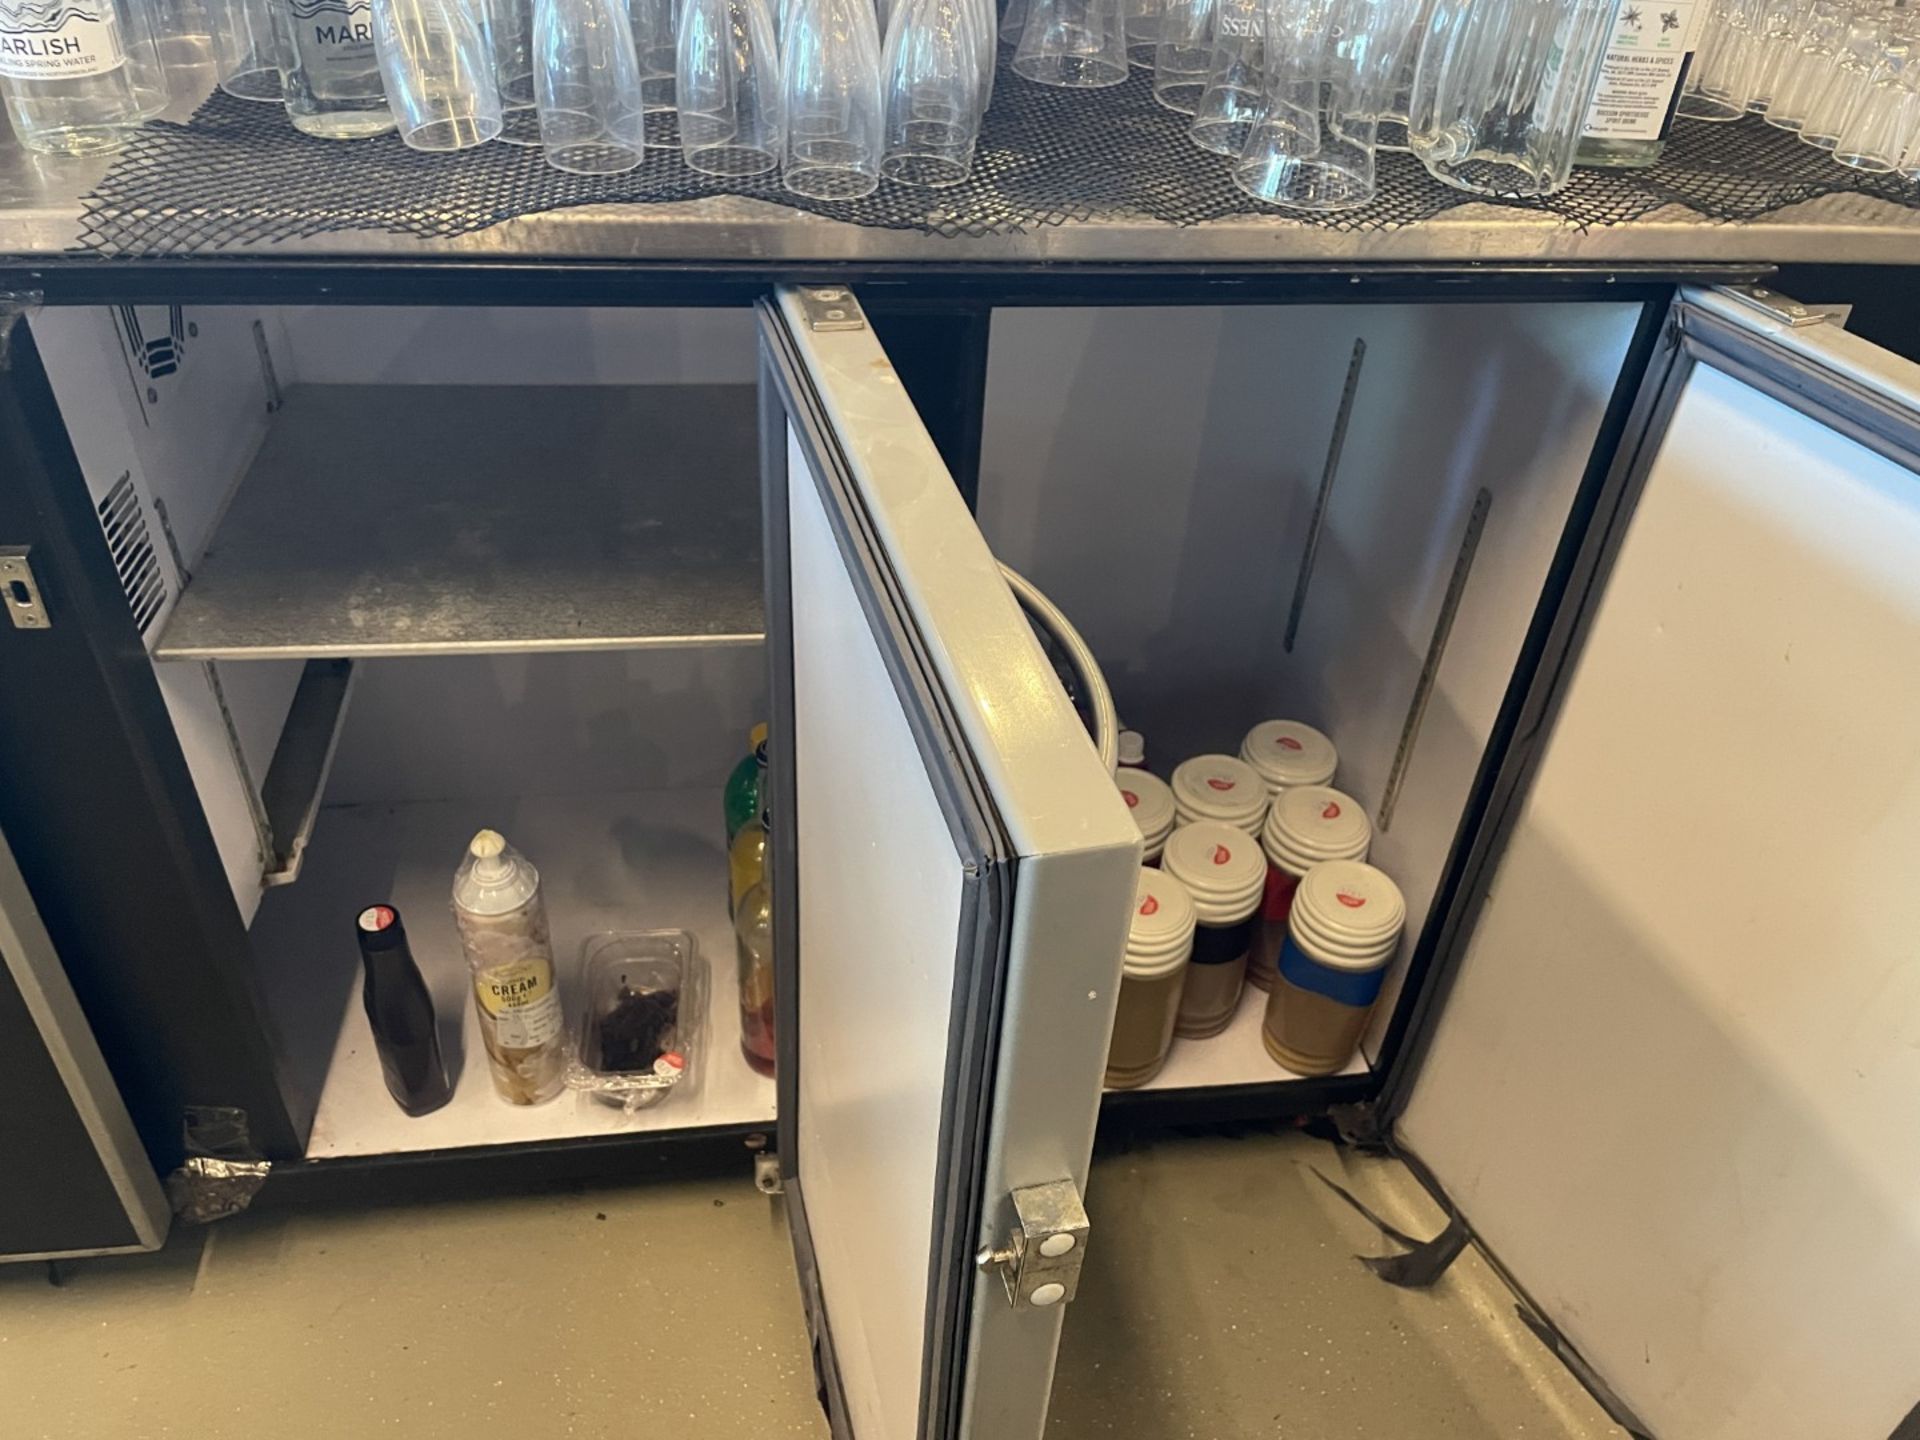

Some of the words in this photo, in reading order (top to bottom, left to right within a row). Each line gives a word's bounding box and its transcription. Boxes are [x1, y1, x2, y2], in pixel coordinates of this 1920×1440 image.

[25, 58, 61, 68] SPRING
[63, 55, 96, 67] WATER
[491, 975, 537, 996] CREAM
